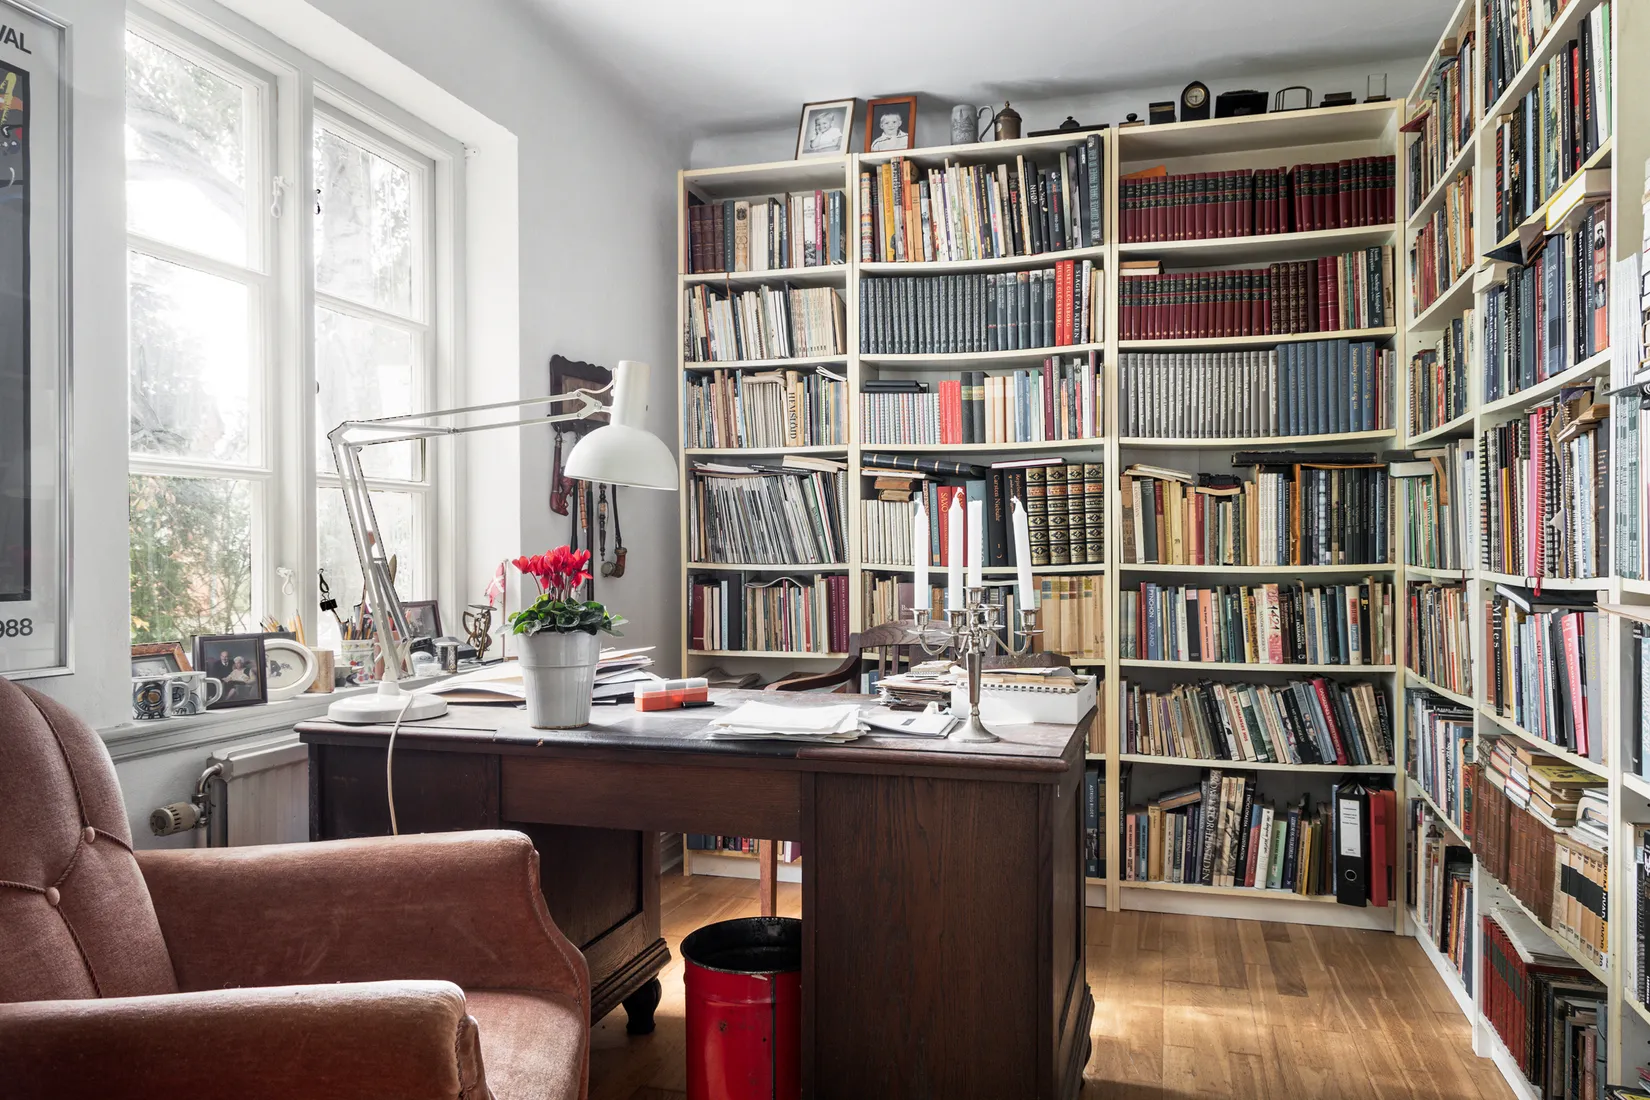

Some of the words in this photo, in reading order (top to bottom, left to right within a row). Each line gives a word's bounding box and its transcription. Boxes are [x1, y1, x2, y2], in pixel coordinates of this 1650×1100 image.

[787, 392, 799, 440] HEMSLÖJD
[993, 475, 1001, 497] Carsten
[994, 498, 1002, 522] Niebuhr
[1268, 606, 1280, 630] 1421
[1493, 604, 1501, 648] Miles
